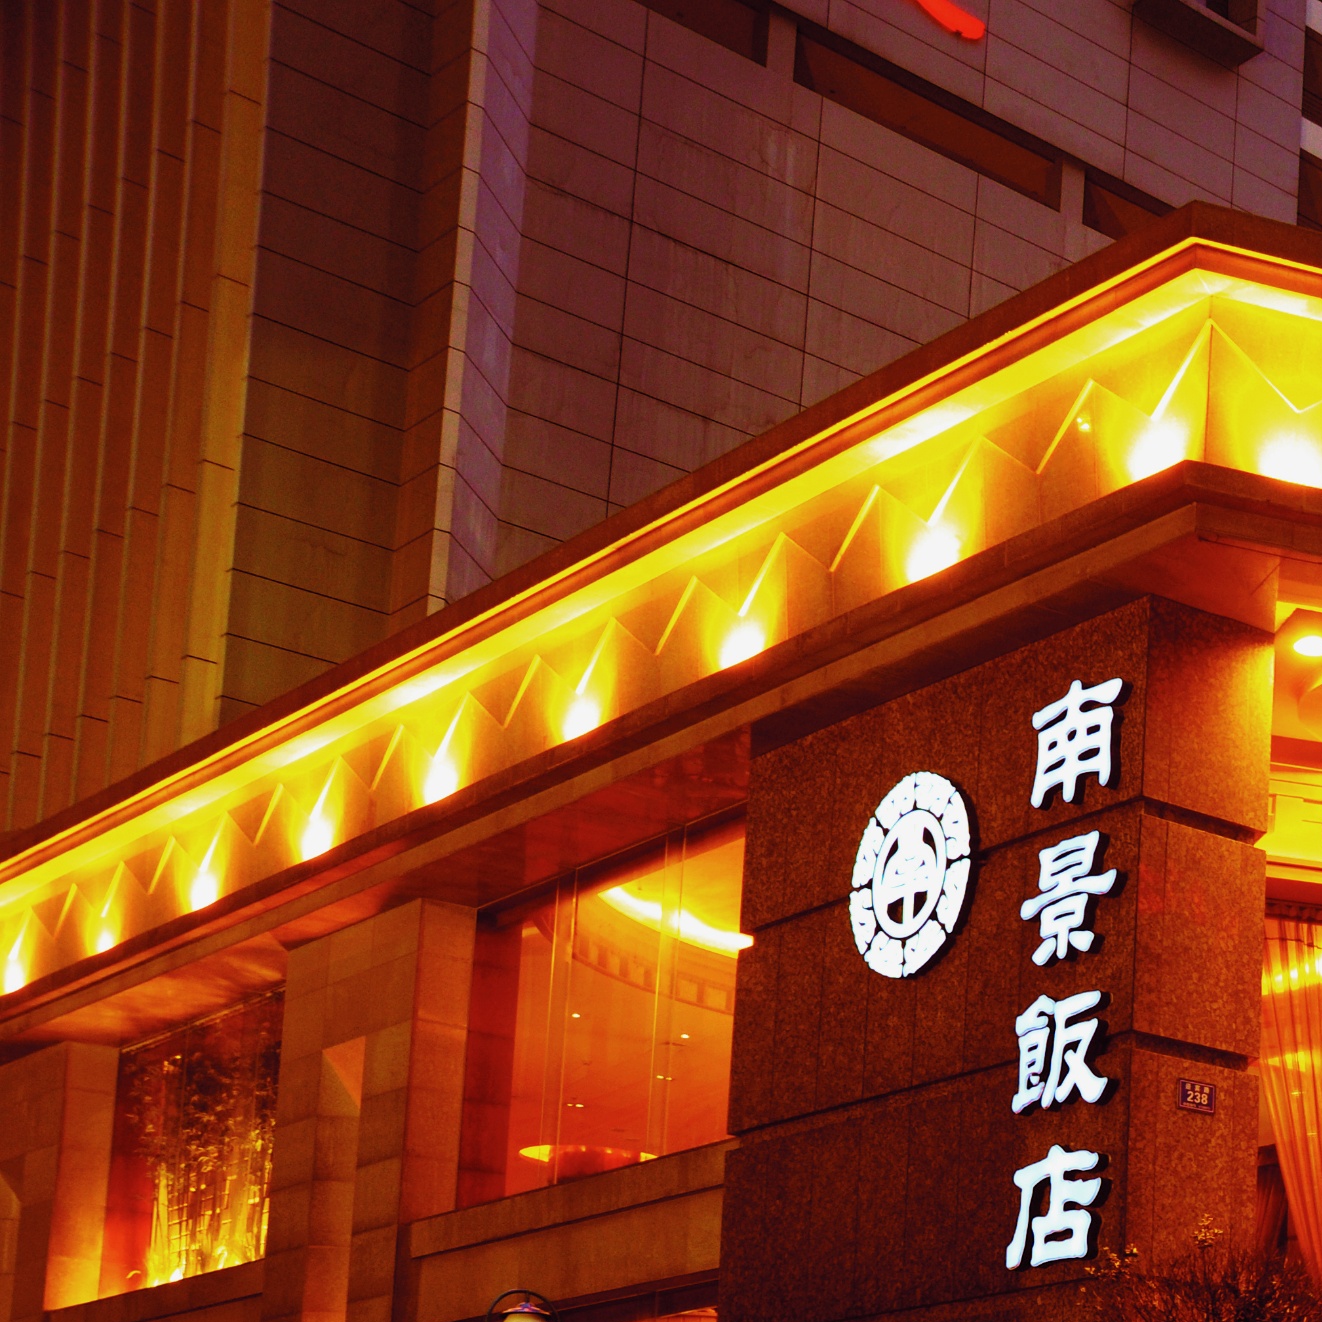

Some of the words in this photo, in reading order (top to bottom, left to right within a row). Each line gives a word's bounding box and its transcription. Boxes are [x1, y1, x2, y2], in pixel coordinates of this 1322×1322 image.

[1005, 678, 1124, 1271] 南景飯店
[1187, 1091, 1208, 1105] 238
